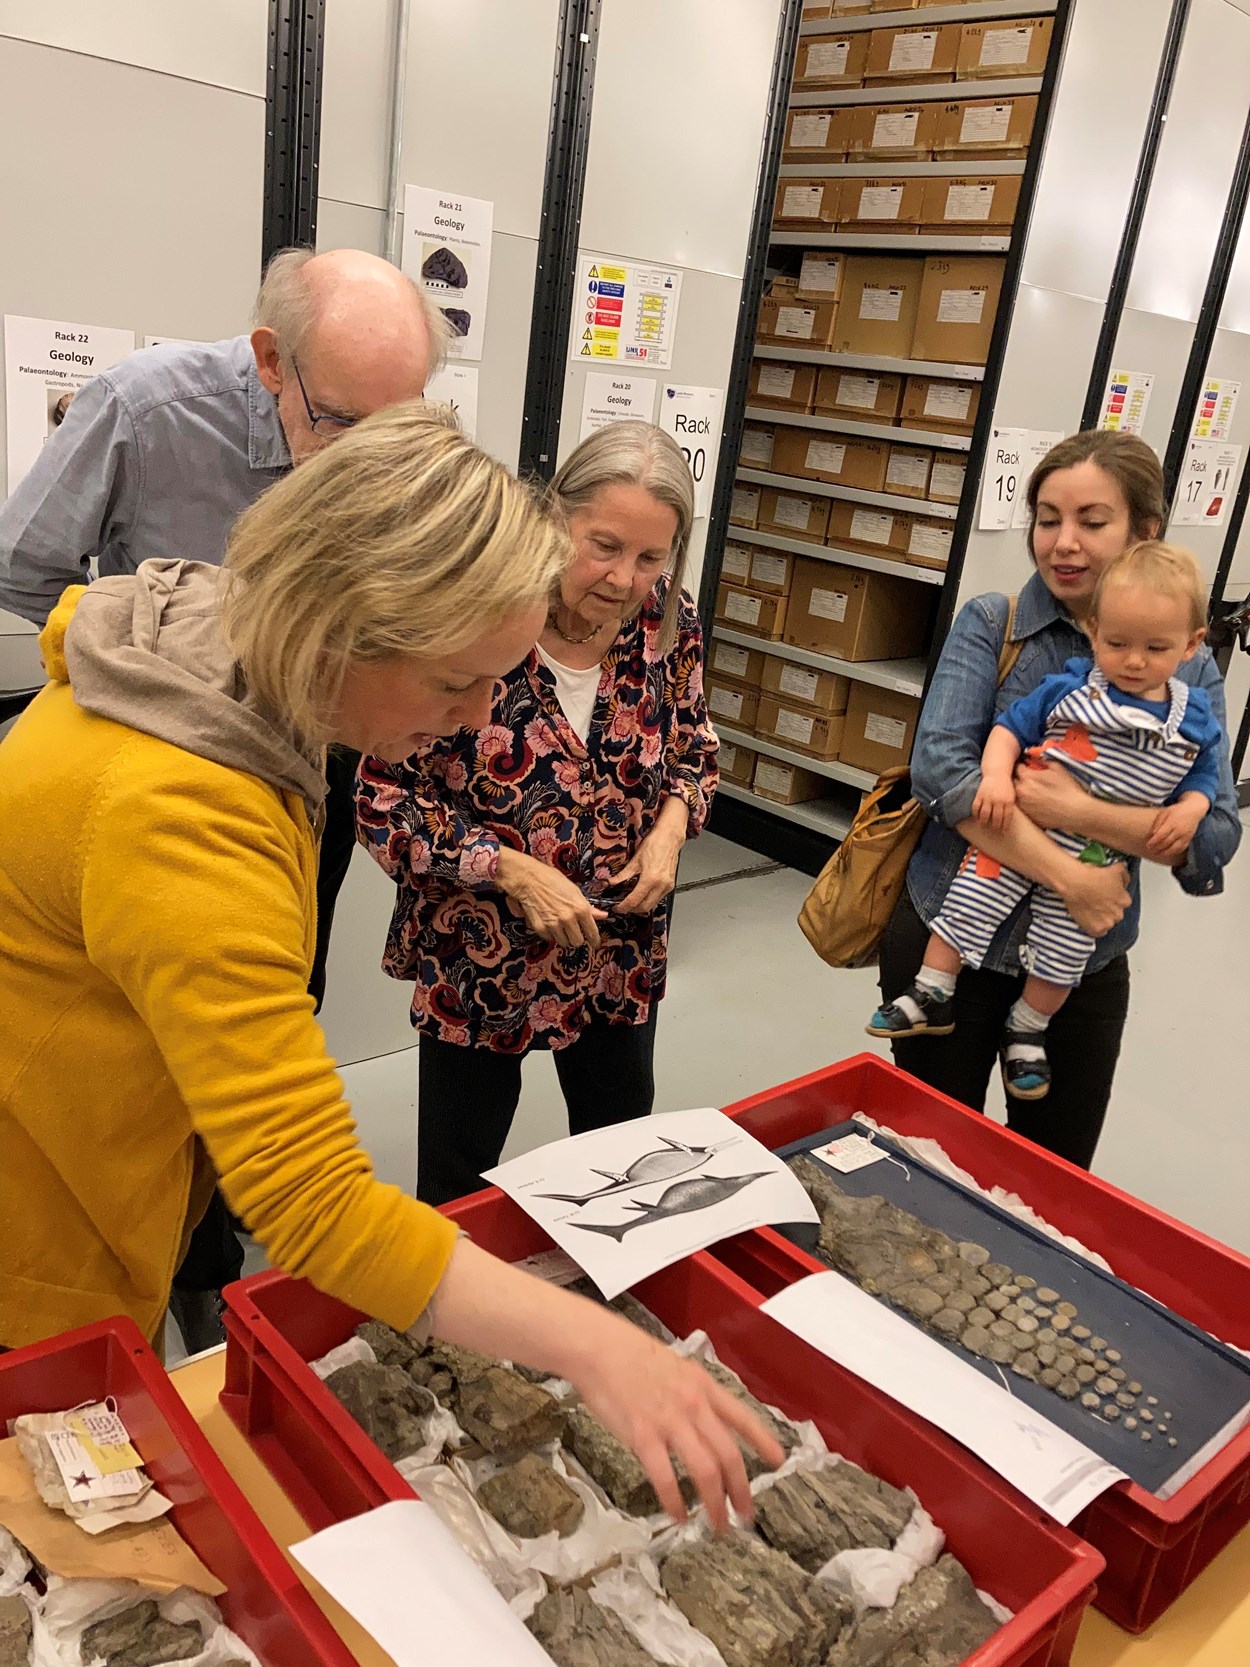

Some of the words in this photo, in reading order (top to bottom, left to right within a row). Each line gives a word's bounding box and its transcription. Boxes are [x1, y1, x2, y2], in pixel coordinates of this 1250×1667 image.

[438, 200, 453, 210] Rack
[454, 203, 462, 211] 21
[434, 216, 465, 231] Geology
[55, 331, 76, 343] Rack
[78, 334, 89, 343] 22
[49, 350, 94, 366] Geology
[44, 379, 76, 389] Gastropods,
[612, 382, 624, 390] Rack
[607, 395, 632, 406] Geology
[675, 414, 711, 435] Rack
[996, 449, 1020, 464] Rack
[1190, 459, 1207, 472] Rack
[995, 475, 1016, 502] 19
[1187, 480, 1202, 502] 17
